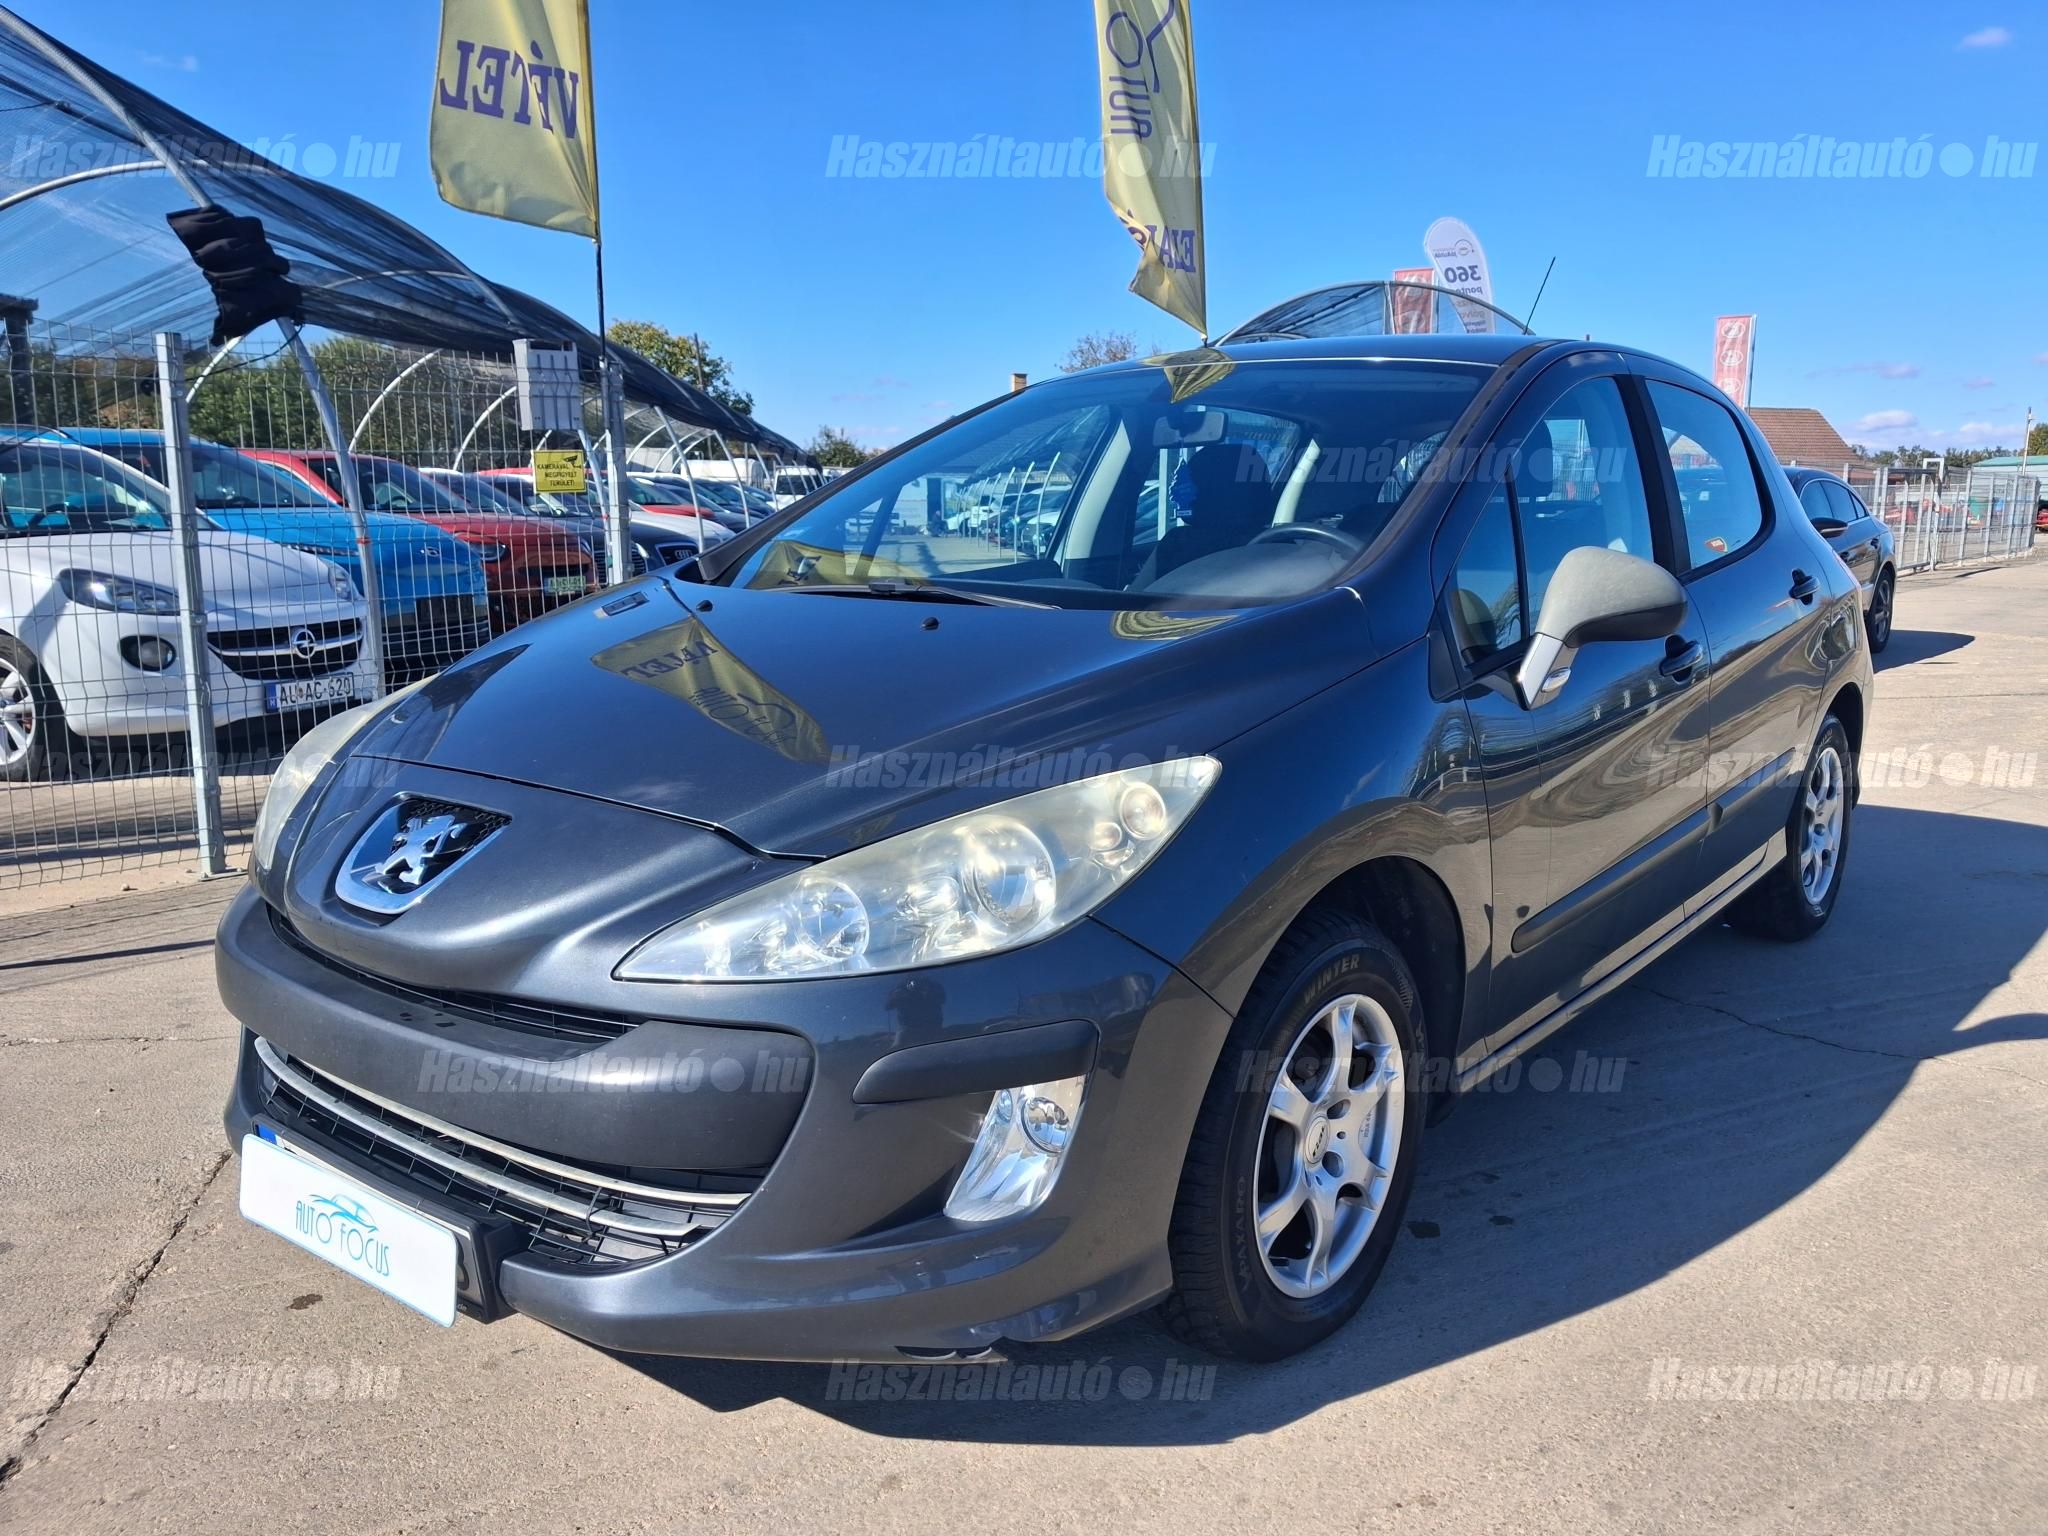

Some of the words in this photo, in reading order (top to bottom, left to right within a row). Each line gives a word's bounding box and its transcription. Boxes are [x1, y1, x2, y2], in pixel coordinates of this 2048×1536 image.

[1304, 954, 1360, 1004] WINTER
[296, 1200, 332, 1244] AUTO
[340, 1223, 389, 1277] FOCUS
